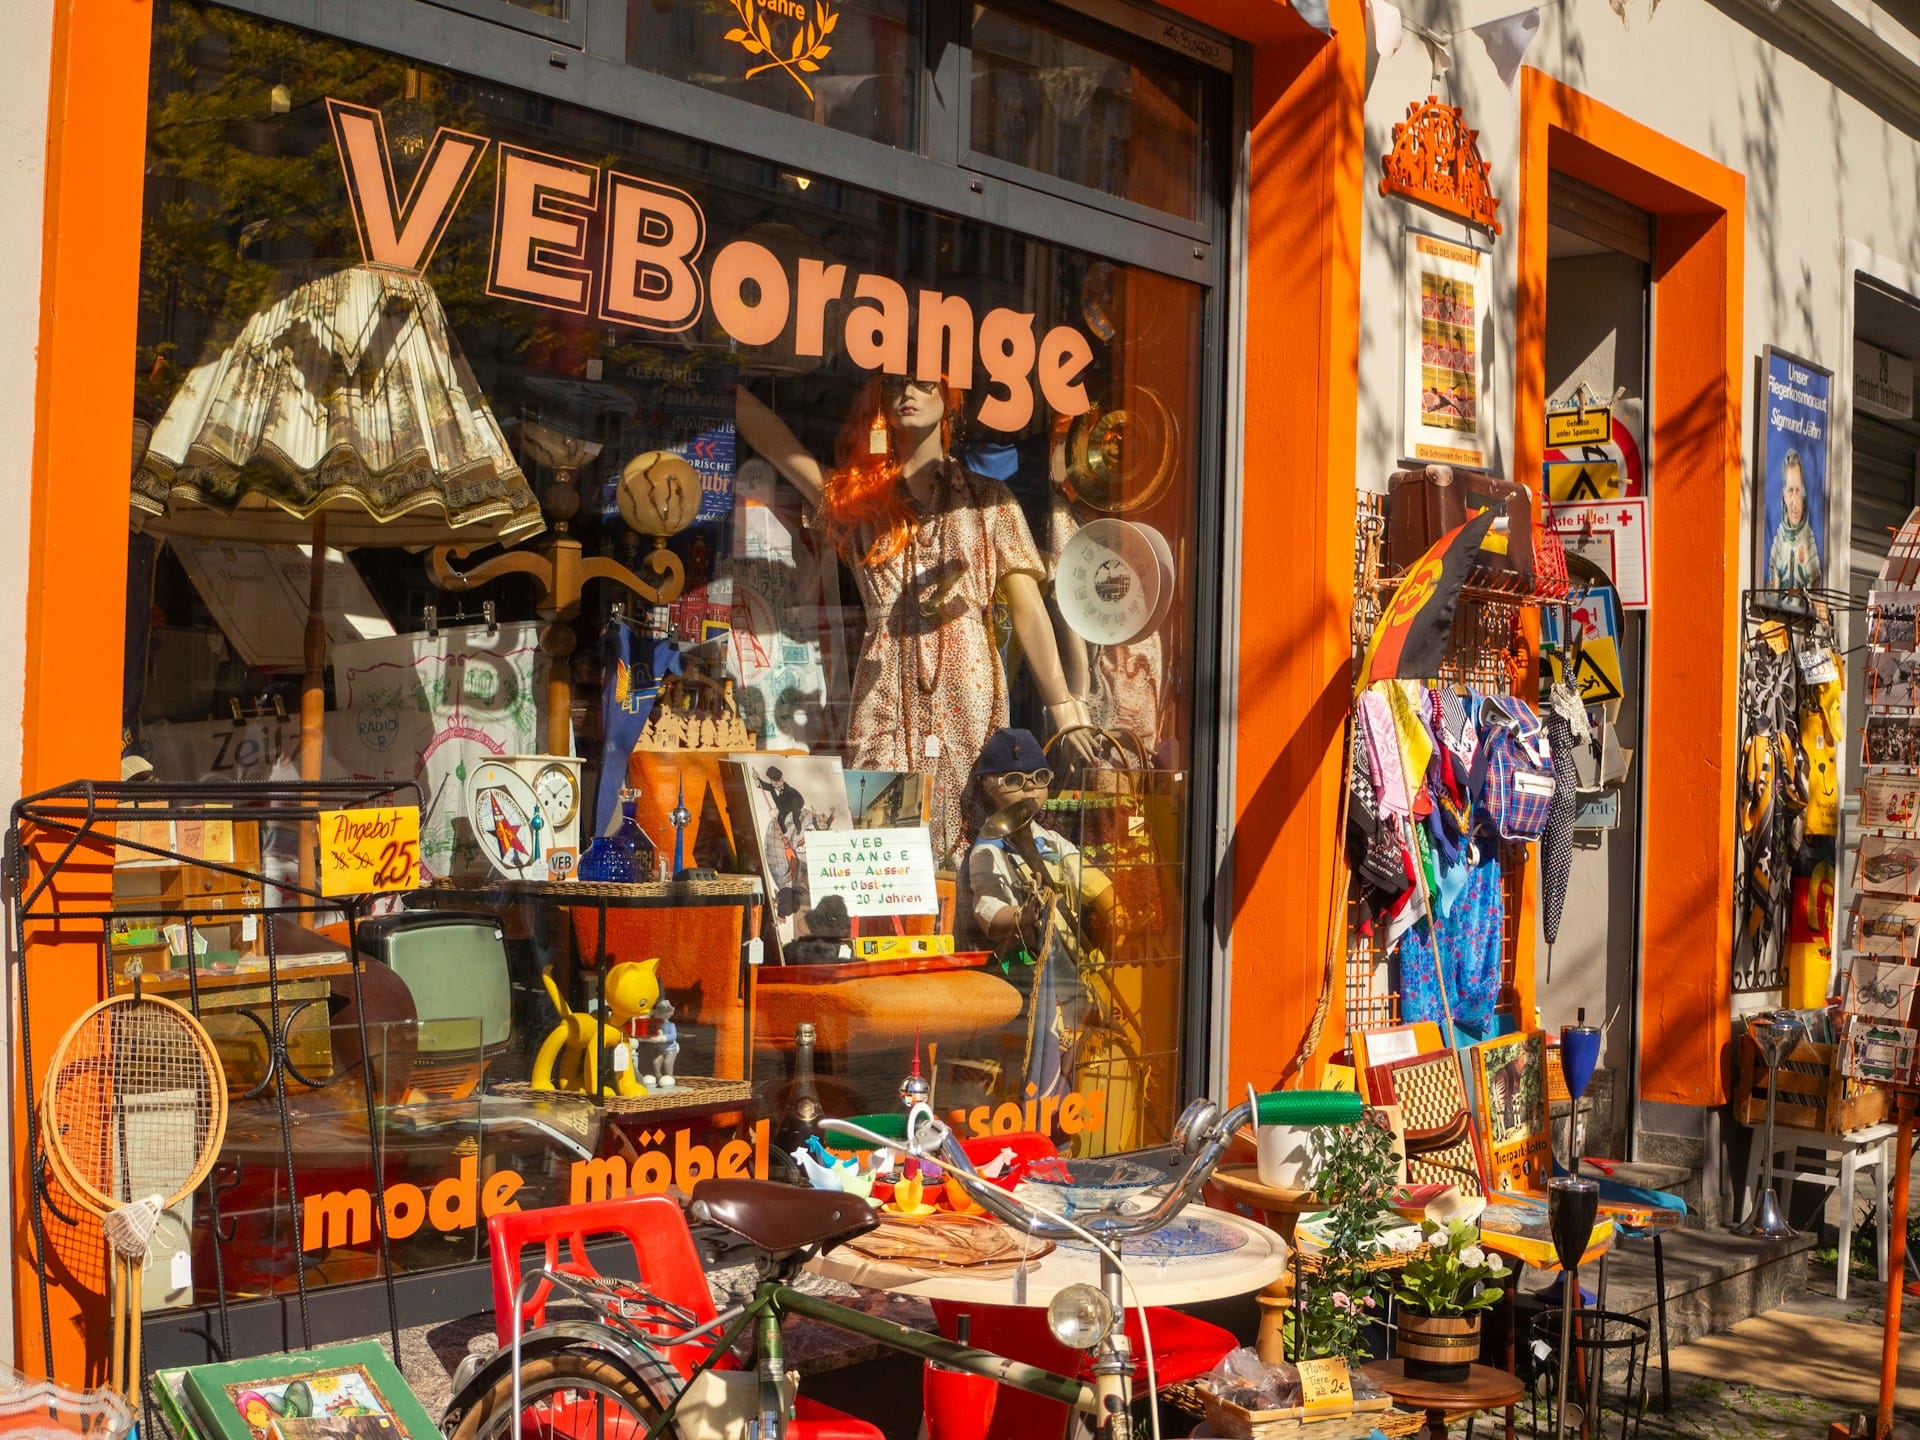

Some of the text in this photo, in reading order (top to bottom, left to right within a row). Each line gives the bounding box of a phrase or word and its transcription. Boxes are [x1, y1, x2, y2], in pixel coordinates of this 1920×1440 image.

[1440, 249, 1450, 258] DES
[1788, 363, 1809, 387] Unser
[1771, 407, 1822, 440] Sigmund Jähn
[1556, 427, 1599, 438] unter Spannung
[1420, 448, 1428, 457] Die
[358, 720, 397, 736] RADIO
[333, 810, 403, 853] Angebot
[850, 837, 883, 848] VEB
[552, 856, 571, 869] VEB
[820, 865, 910, 877] Alles Ausser
[856, 893, 922, 904] 20 Jahren
[1494, 1139, 1547, 1165] Tierpark-Lotto
[303, 1118, 770, 1252] mode möbel
